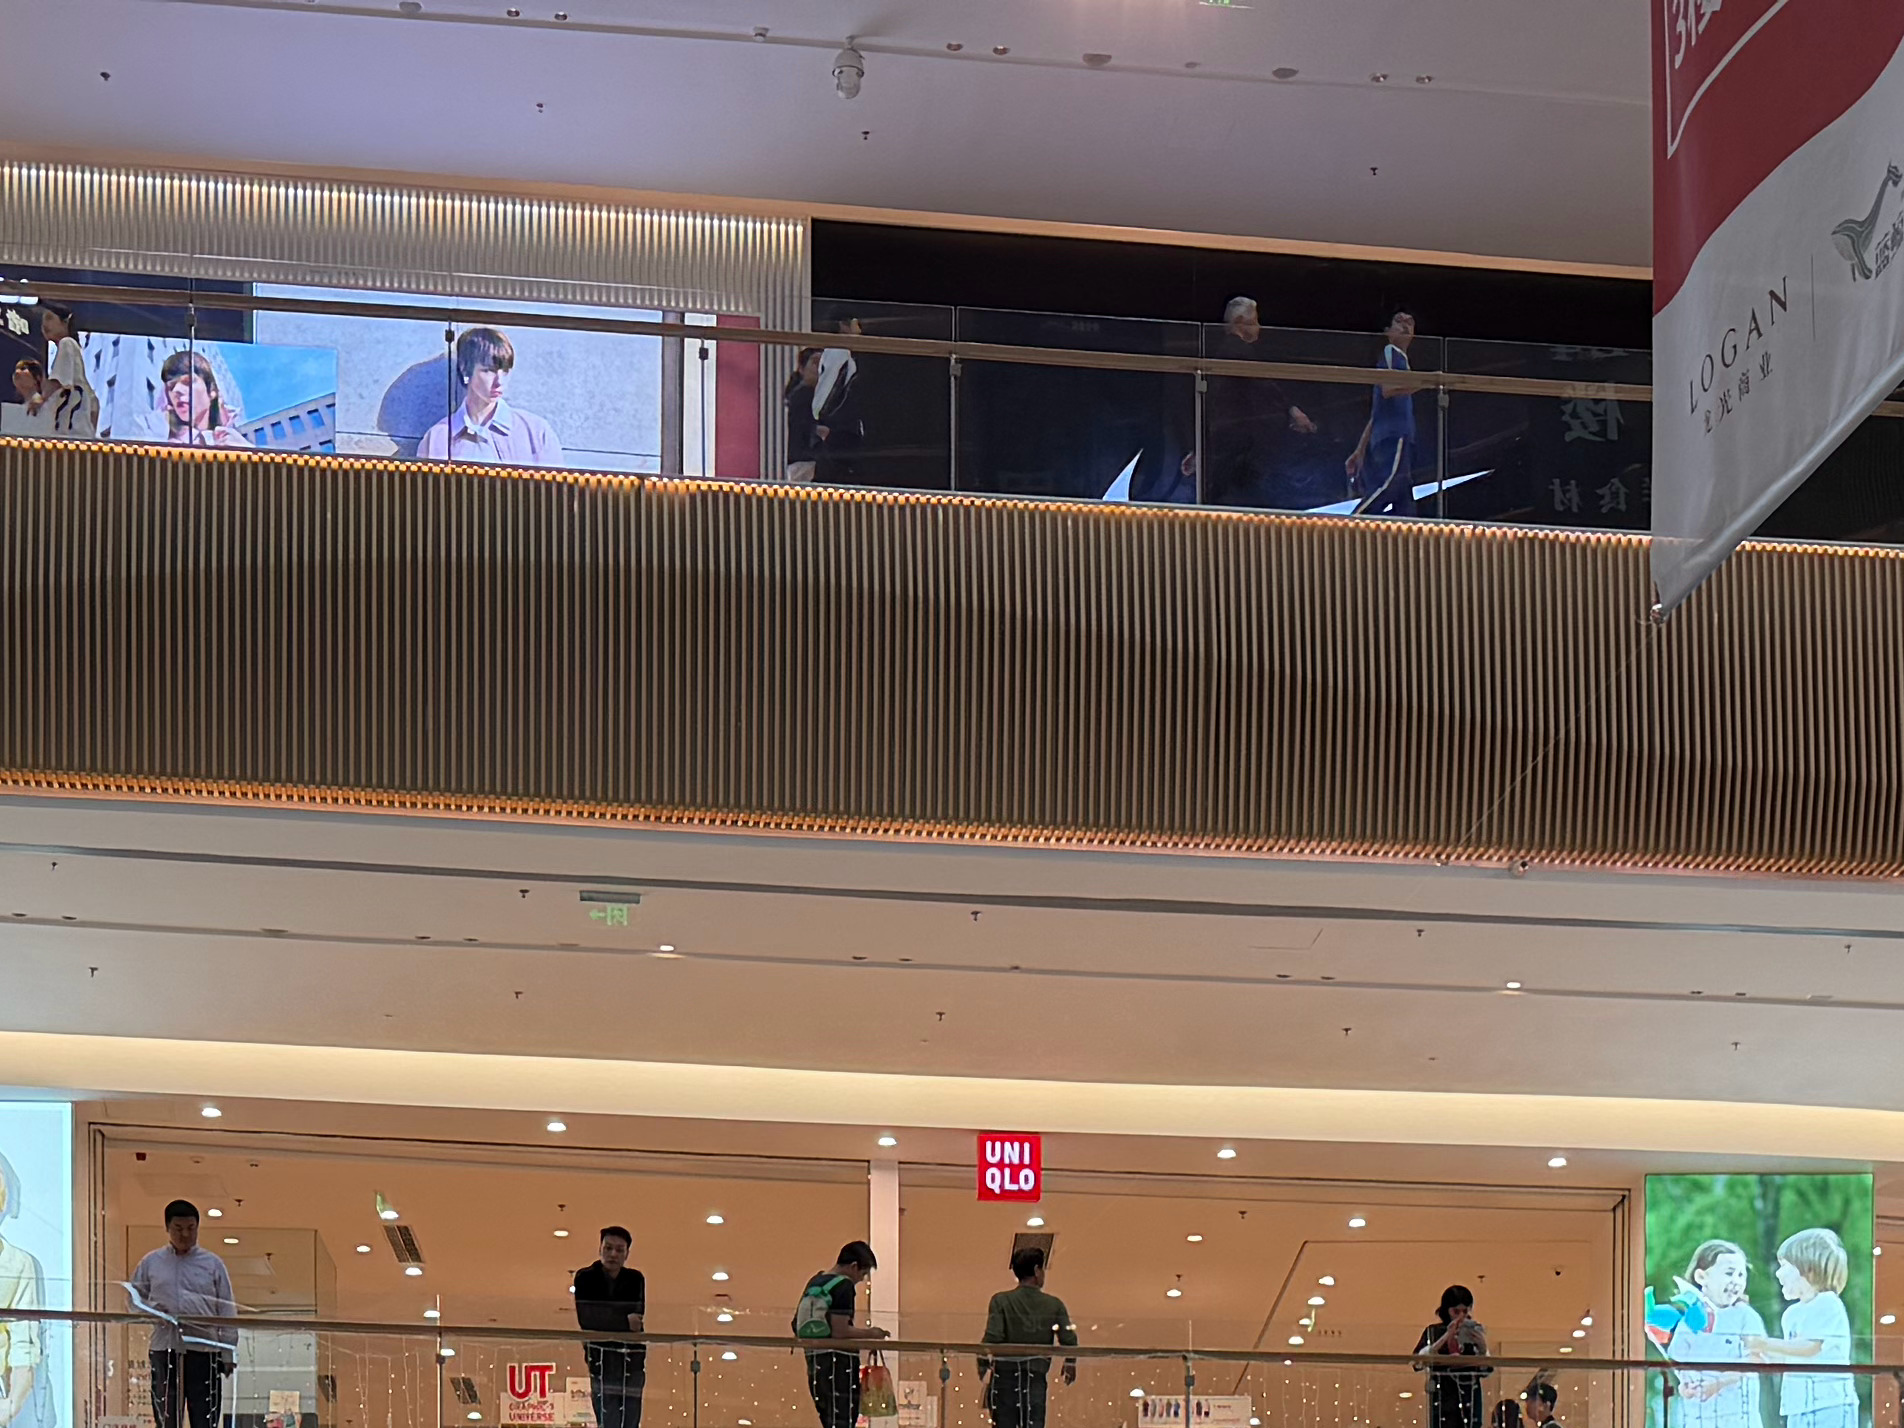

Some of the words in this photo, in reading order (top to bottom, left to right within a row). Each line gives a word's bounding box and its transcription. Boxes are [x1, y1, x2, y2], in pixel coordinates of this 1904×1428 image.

[1688, 275, 1790, 415] LOGAN
[985, 1142, 1031, 1165] UNI
[985, 1168, 1035, 1193] QLO
[507, 1363, 556, 1401] UT
